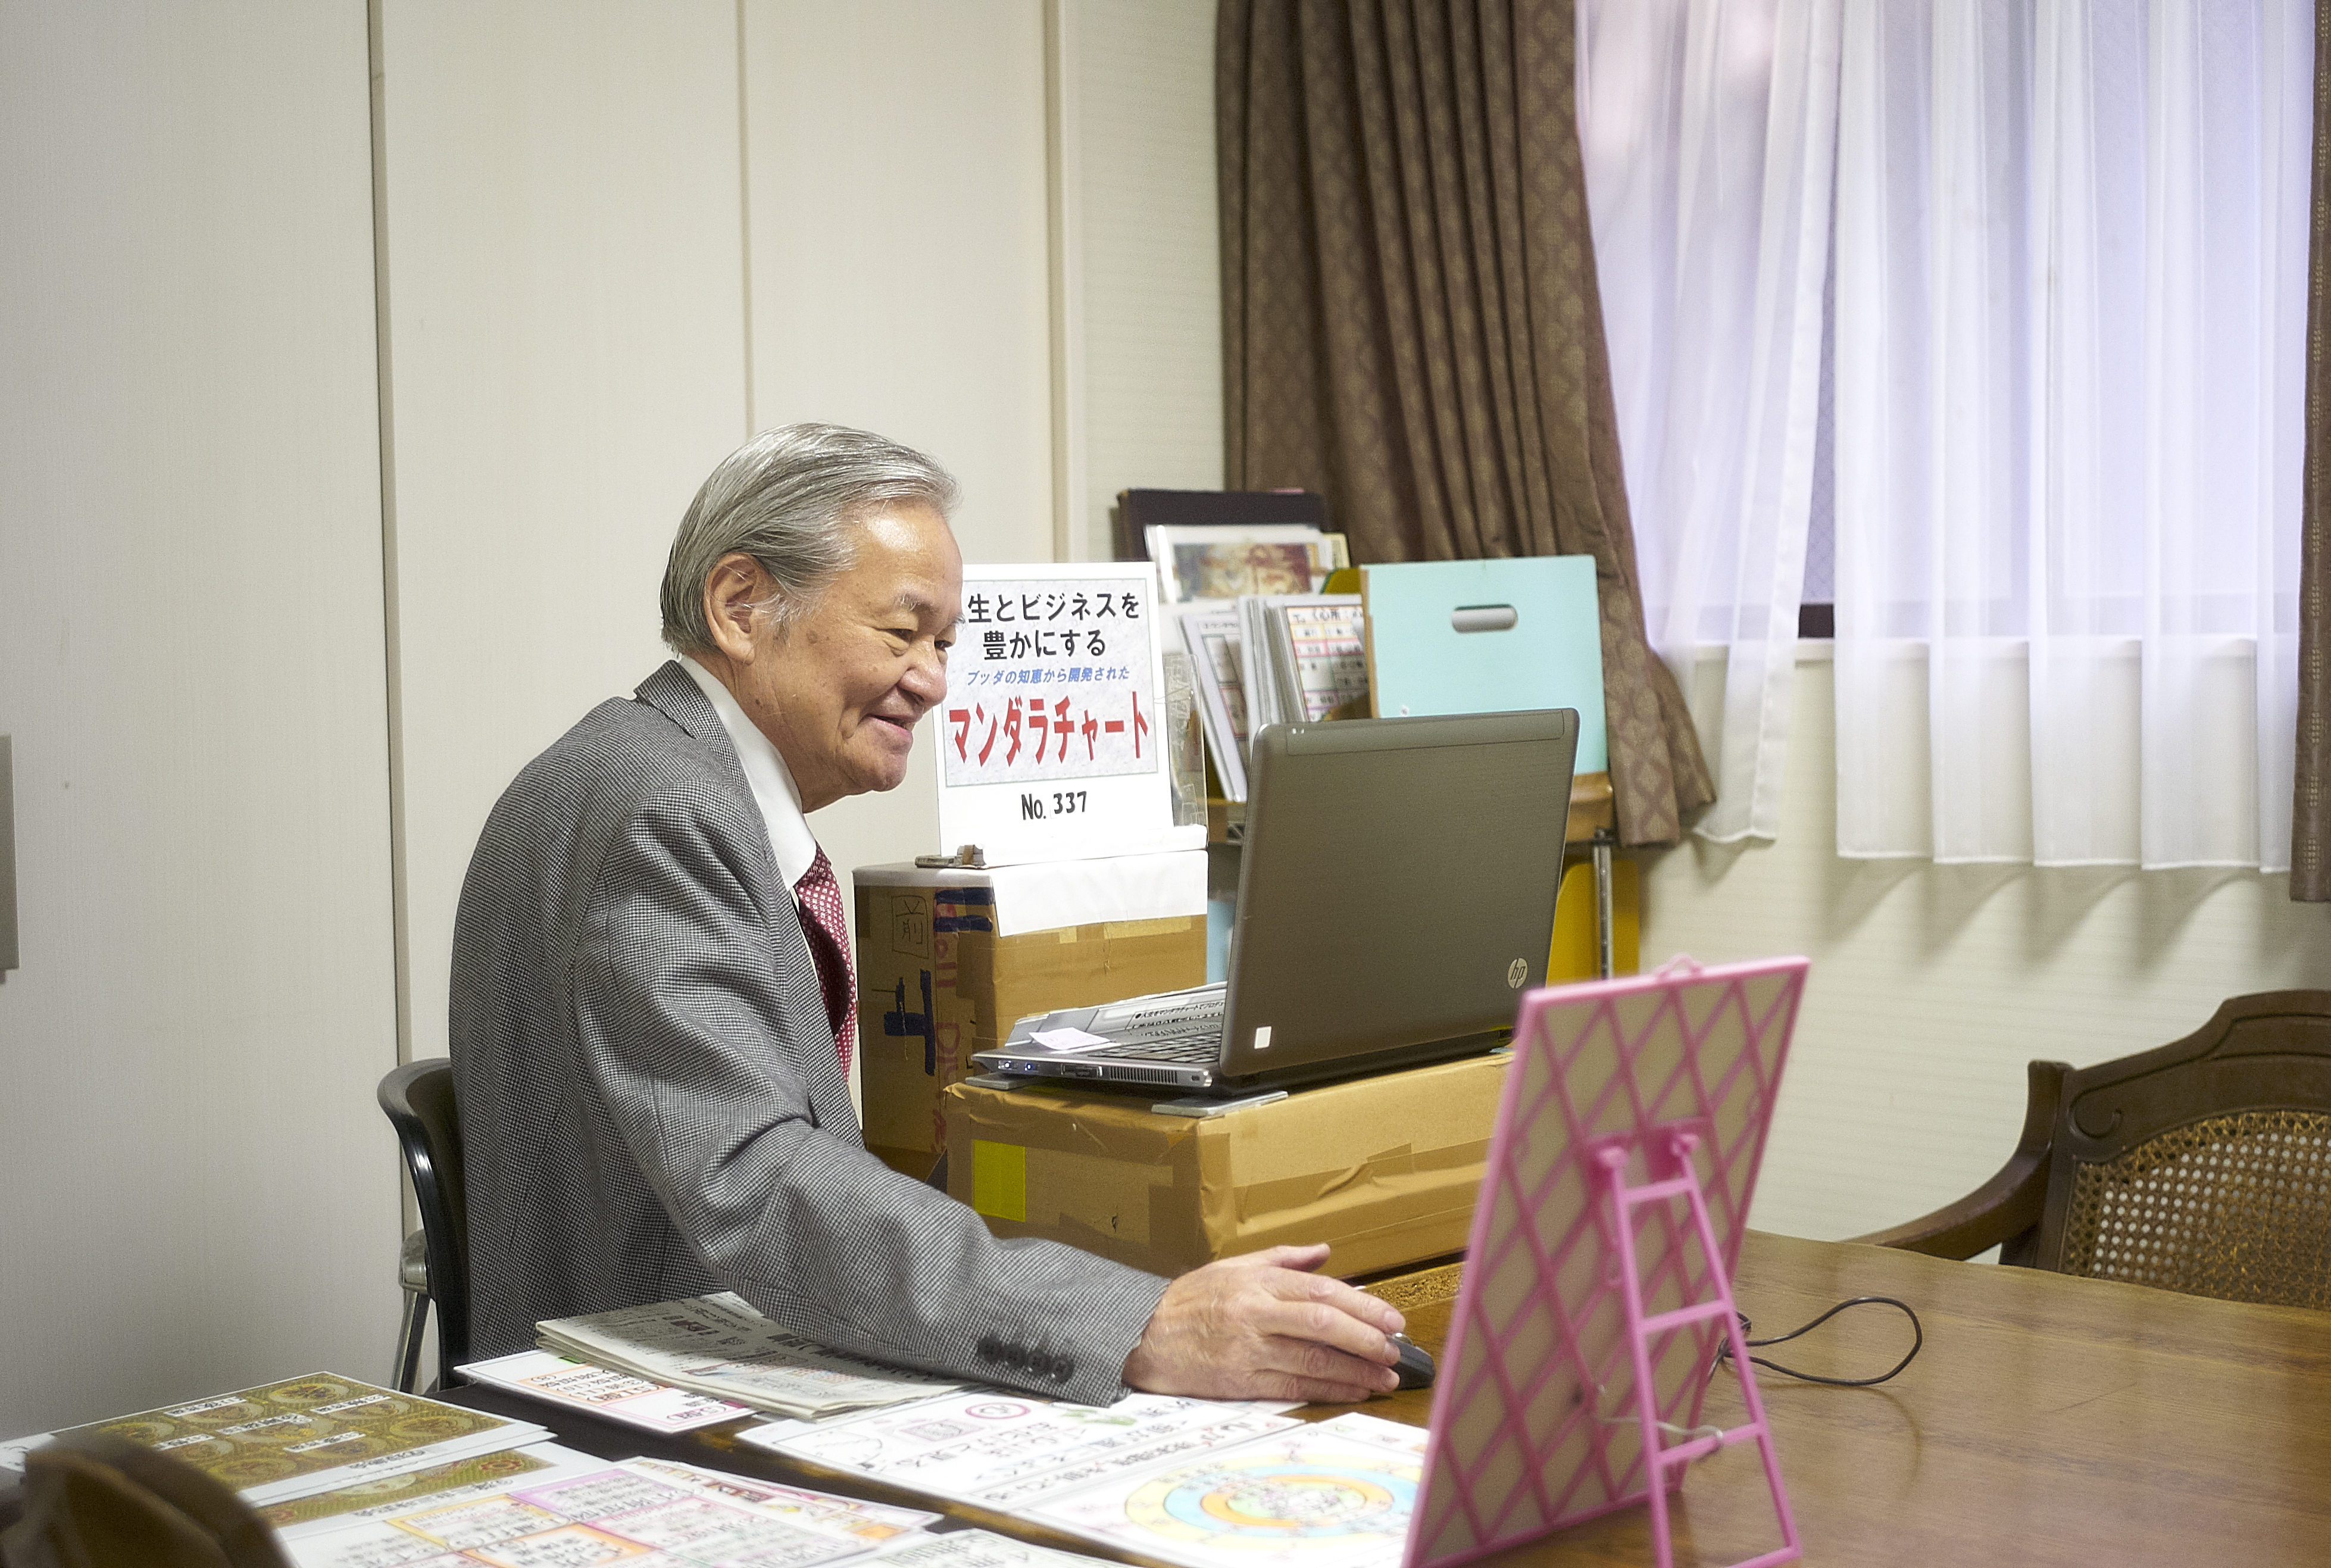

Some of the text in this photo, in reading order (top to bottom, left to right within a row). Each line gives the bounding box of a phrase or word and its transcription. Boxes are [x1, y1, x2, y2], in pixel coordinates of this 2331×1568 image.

[983, 629, 1105, 660] 豊かにする
[967, 666, 1130, 685] ブッダの知恵から開発された
[949, 691, 1148, 767] マンダラチャート
[1021, 791, 1087, 820] No. 337
[1510, 958, 1526, 988] hp
